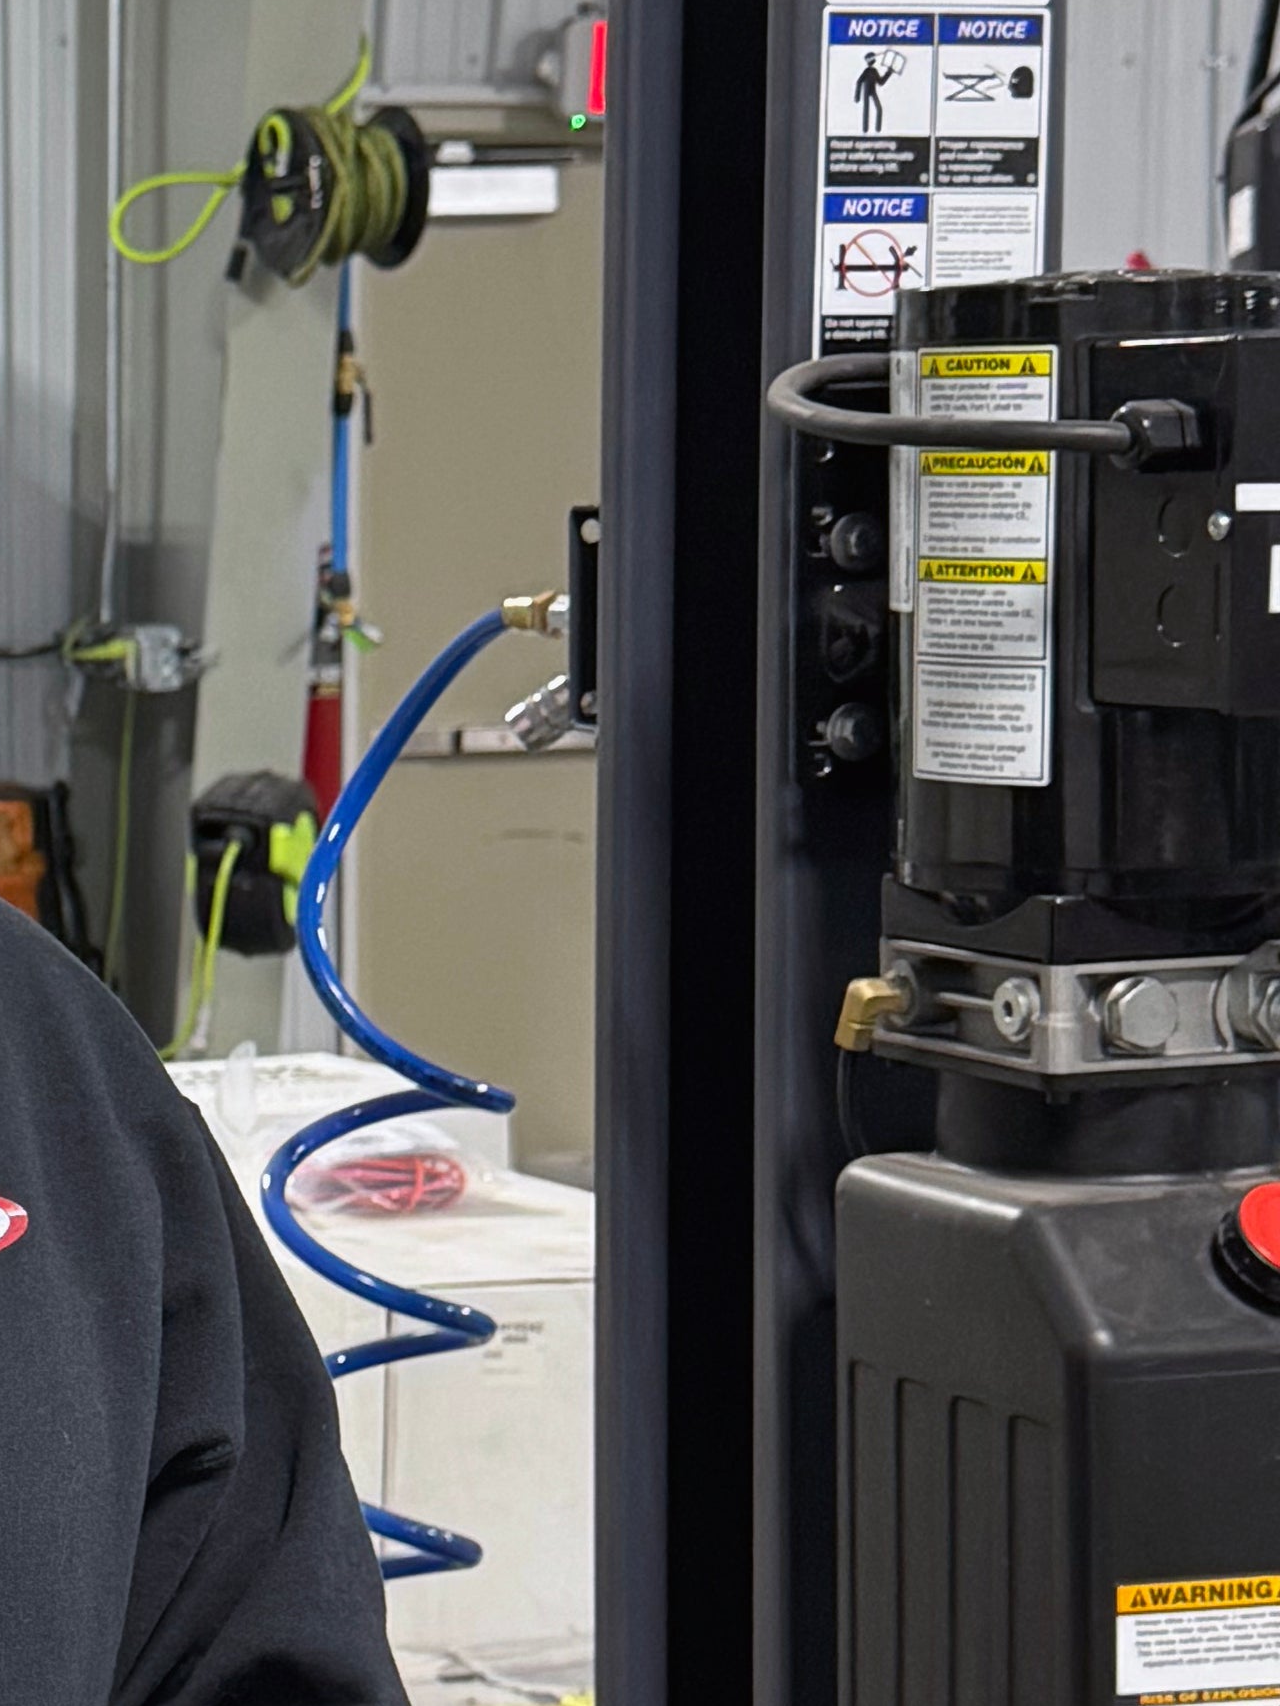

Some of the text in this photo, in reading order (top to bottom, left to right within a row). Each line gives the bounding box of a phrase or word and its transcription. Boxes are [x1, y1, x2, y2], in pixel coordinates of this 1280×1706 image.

[848, 19, 919, 38] NOTICE
[957, 21, 1027, 40] NOTICE
[842, 198, 915, 216] NOTICE
[946, 359, 1011, 372] CAUTION
[931, 454, 1027, 470] PRECAUCIÓN
[935, 564, 1015, 577] ATTENTION
[1148, 1580, 1273, 1606] WARNING
